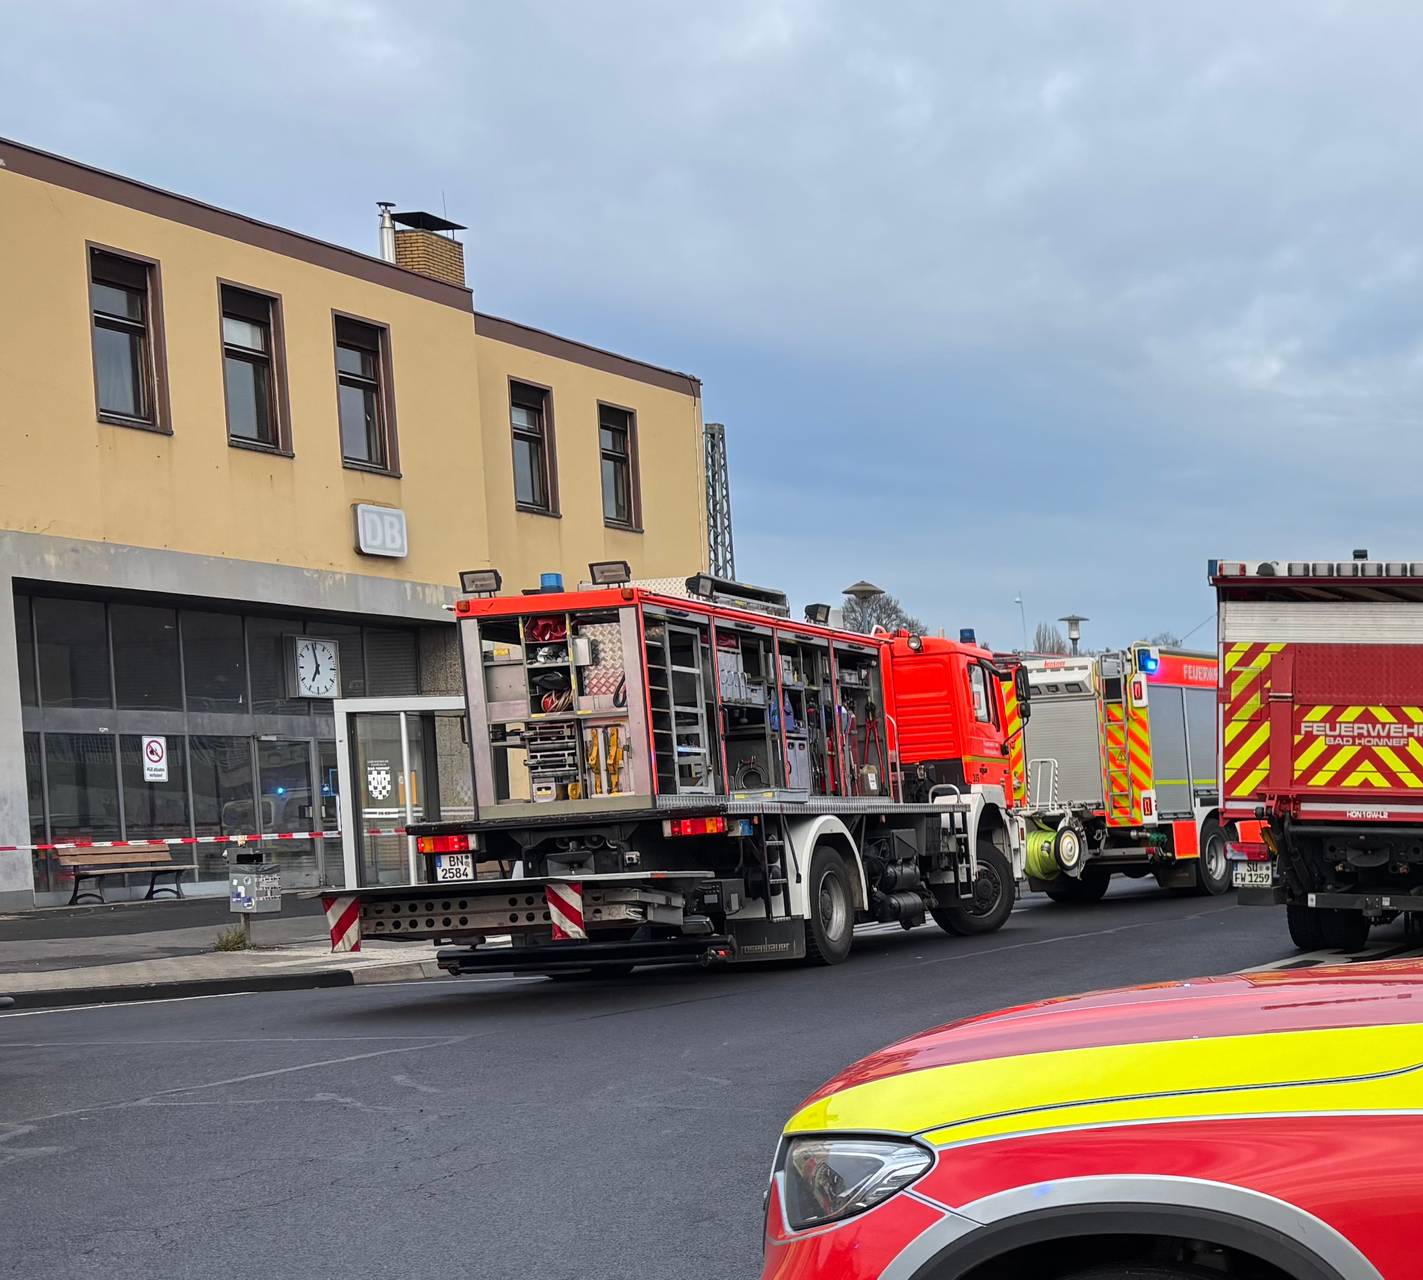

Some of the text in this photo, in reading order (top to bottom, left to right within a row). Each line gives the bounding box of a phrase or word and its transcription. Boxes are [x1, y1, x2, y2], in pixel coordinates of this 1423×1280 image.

[364, 511, 402, 549] DB
[1183, 664, 1218, 681] FEUERW
[1325, 737, 1408, 746] BAD HONNEF
[448, 855, 464, 867] BN
[1246, 861, 1258, 872] SU
[441, 868, 469, 879] 2584
[1234, 872, 1270, 883] FW 1259
